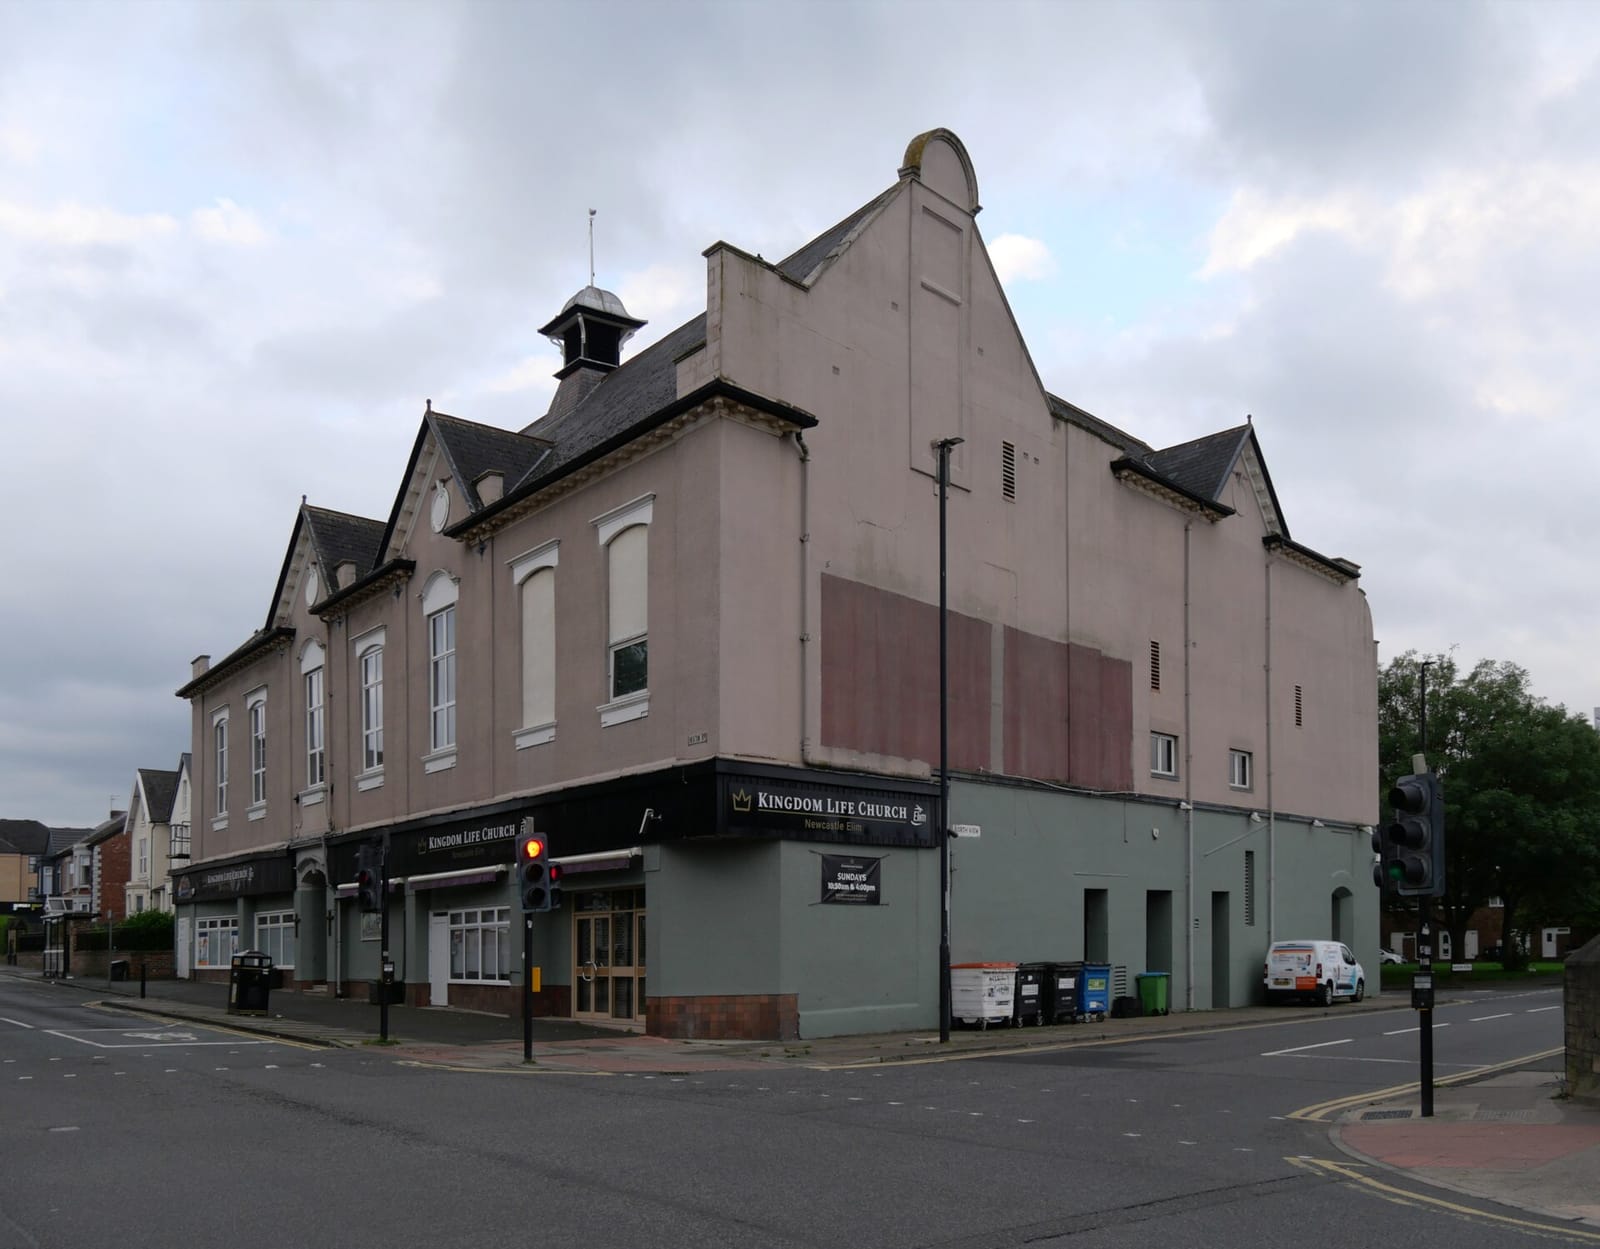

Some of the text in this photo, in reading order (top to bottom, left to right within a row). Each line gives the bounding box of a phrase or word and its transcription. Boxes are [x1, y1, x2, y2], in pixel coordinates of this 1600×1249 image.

[758, 791, 907, 820] KINGDOM LIFE CHURCH
[804, 819, 862, 832] Newcastle Elim
[837, 872, 867, 882] SUNDAYS
